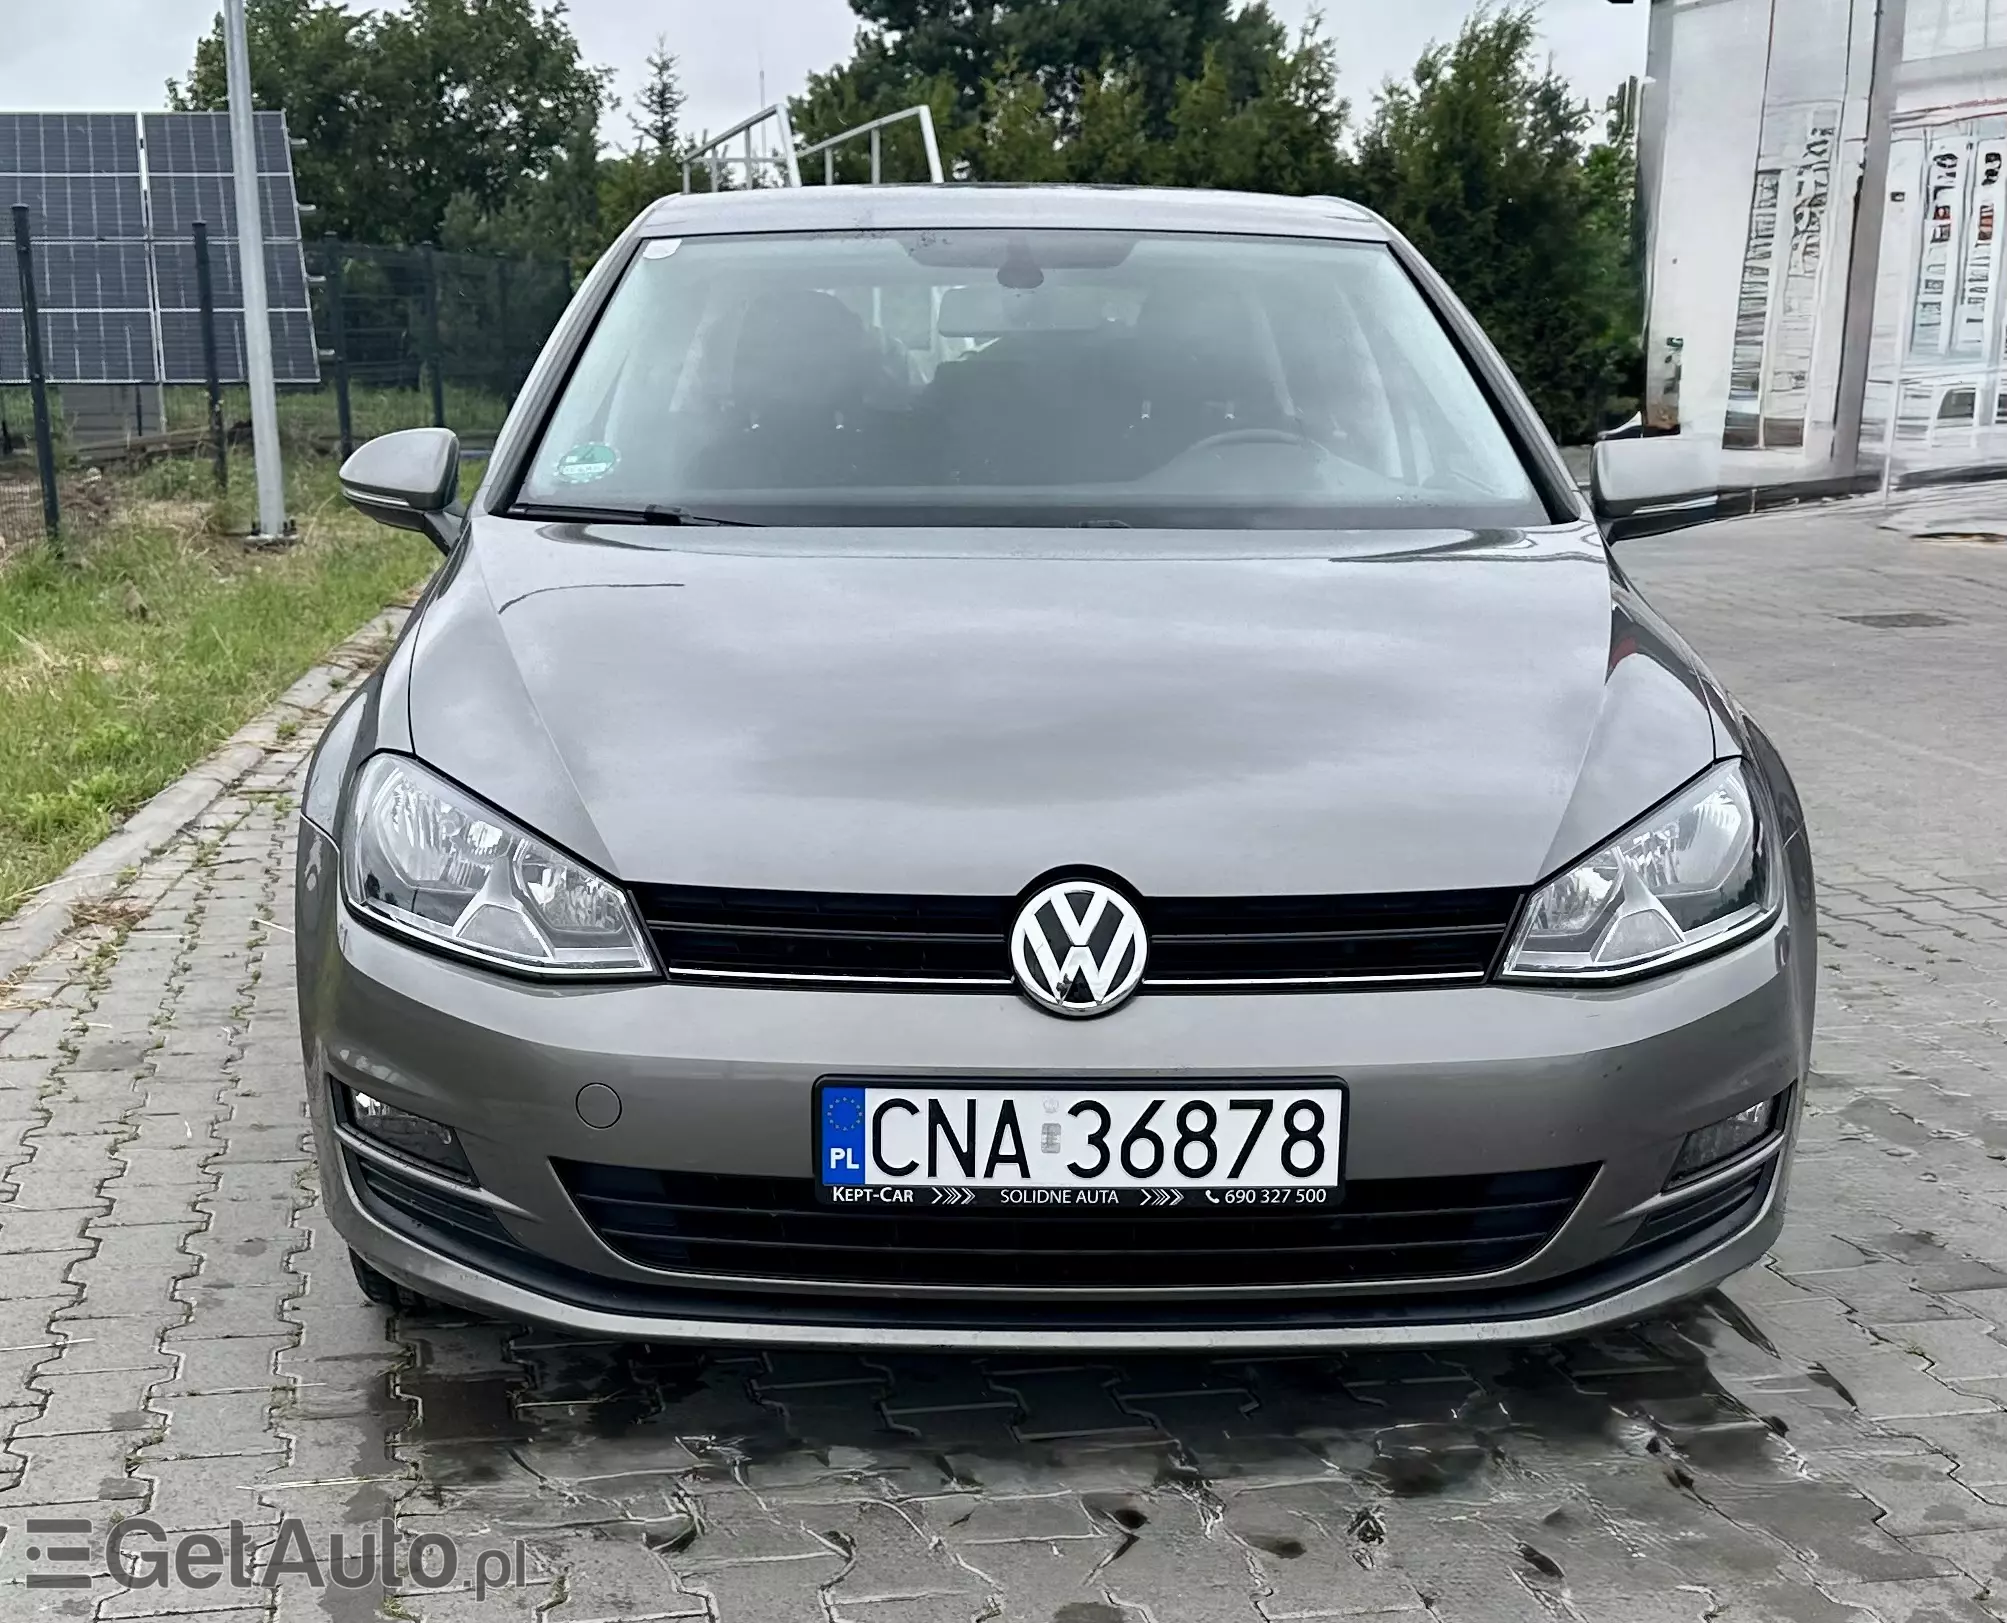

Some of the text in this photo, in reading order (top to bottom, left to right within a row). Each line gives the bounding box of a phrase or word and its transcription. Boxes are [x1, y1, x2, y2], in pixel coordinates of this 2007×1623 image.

[872, 1097, 1326, 1179] CNA 36878
[830, 1147, 860, 1169] PL
[1000, 1188, 1073, 1204] SOLIDNE
[1076, 1189, 1120, 1204] AUTA
[1224, 1188, 1257, 1204] 690
[1260, 1188, 1292, 1204] 327
[1295, 1188, 1327, 1204] 500
